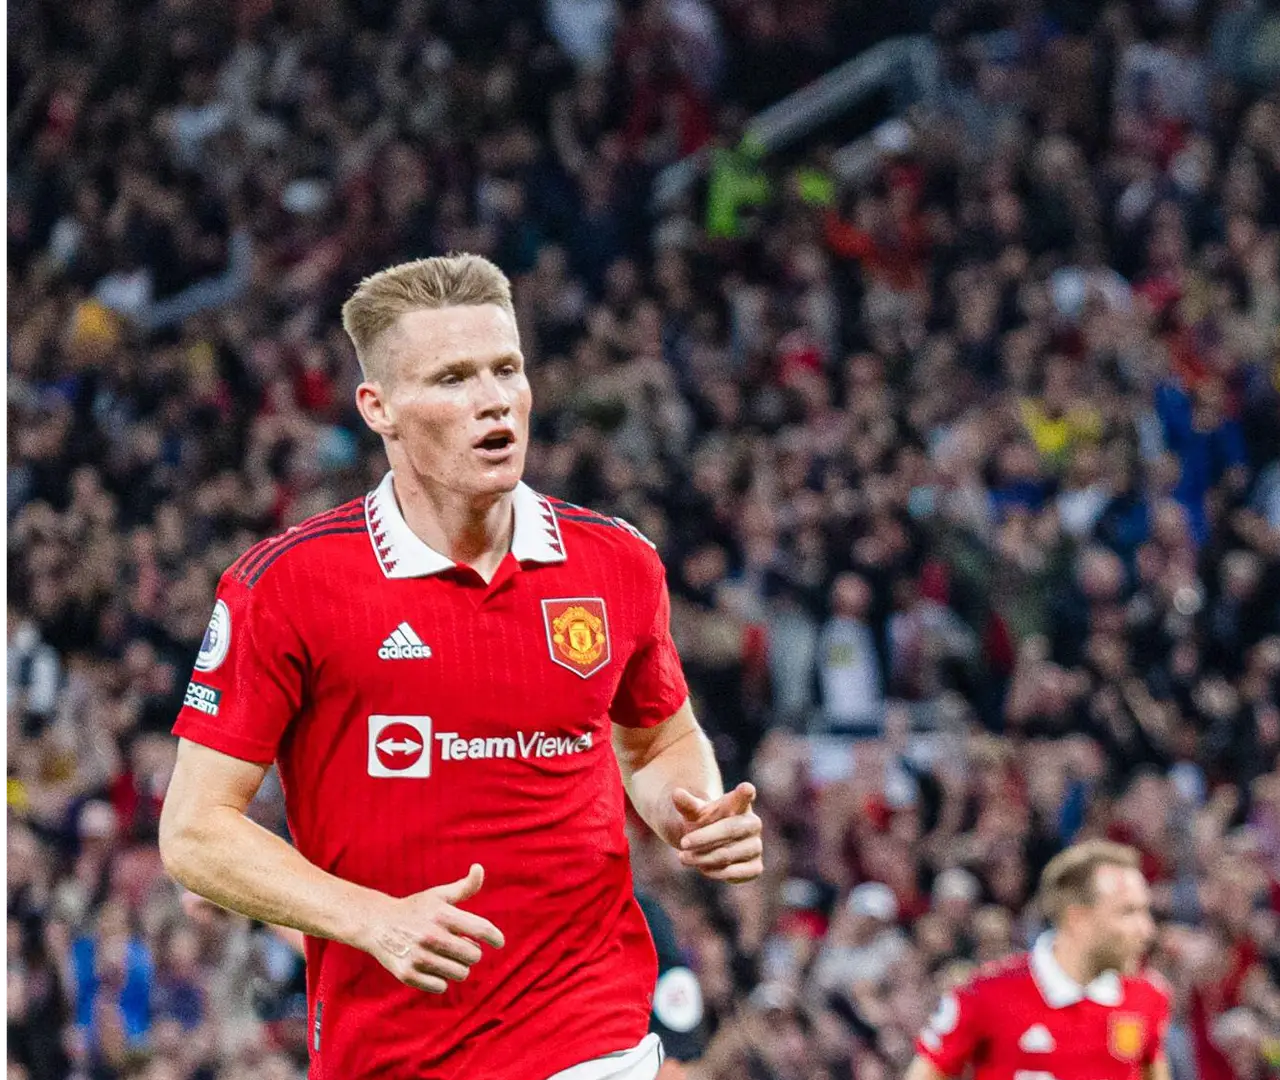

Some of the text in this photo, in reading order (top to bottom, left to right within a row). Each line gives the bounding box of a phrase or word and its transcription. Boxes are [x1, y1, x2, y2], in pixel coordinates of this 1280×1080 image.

[378, 643, 432, 660] adidas
[186, 682, 216, 703] oom
[183, 693, 220, 717] acism
